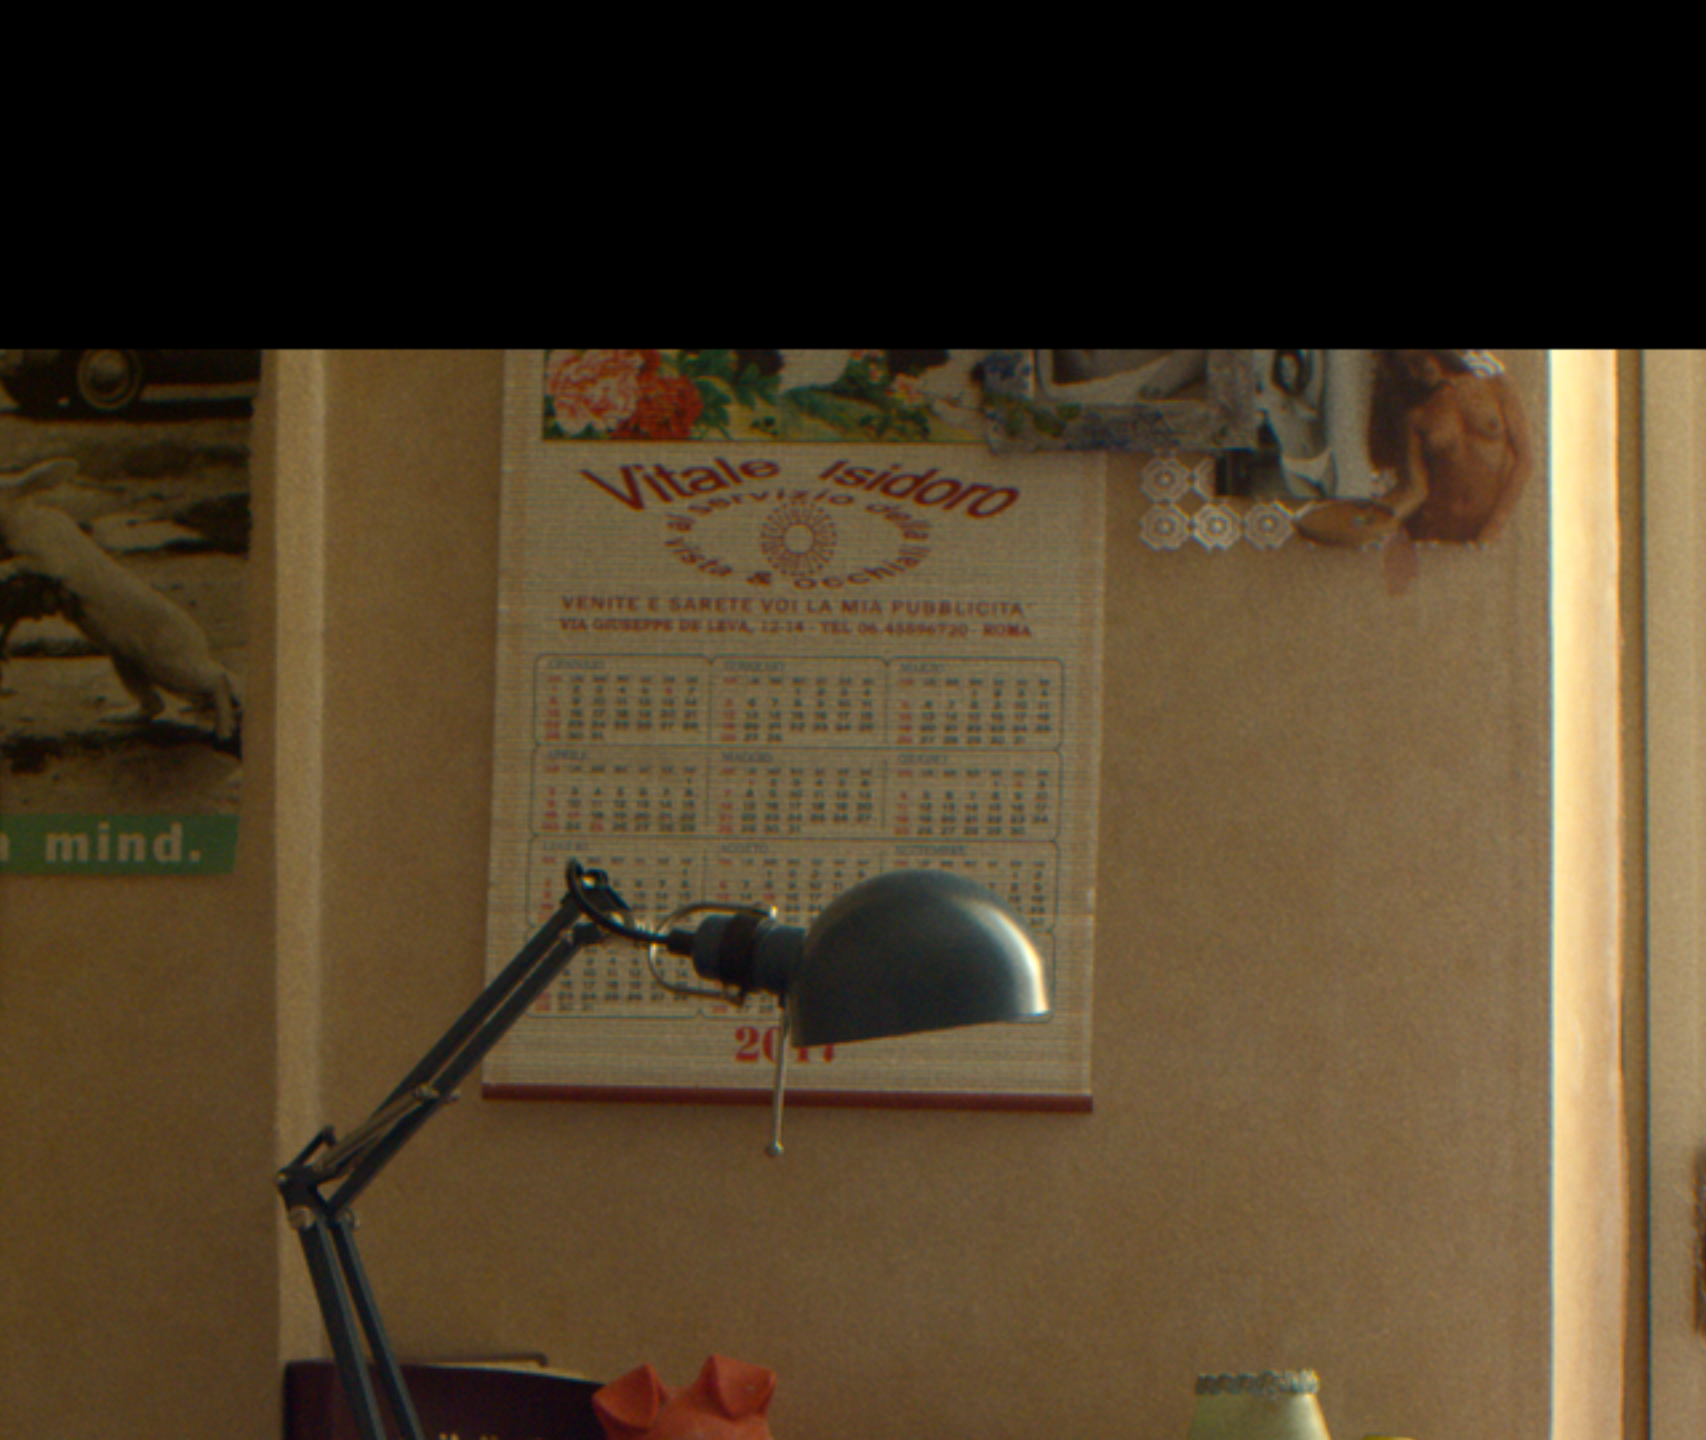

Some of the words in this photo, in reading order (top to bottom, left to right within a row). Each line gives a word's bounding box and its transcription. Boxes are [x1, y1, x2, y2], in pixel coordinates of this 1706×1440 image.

[581, 457, 782, 511] Vitale
[819, 459, 1020, 519] Isidoro
[688, 489, 854, 516] servizio
[664, 537, 733, 578] vista
[747, 571, 772, 586] &
[562, 596, 639, 611] VENITE
[648, 596, 659, 611] E
[668, 597, 752, 612] SARETE
[760, 599, 798, 613] VOI
[807, 599, 831, 613] LA
[841, 600, 882, 614] MIA
[559, 618, 588, 631] VIA
[679, 619, 701, 632] DE
[708, 620, 753, 634] LEVA,
[983, 623, 1032, 637] ROMA
[45, 826, 203, 864] mind.
